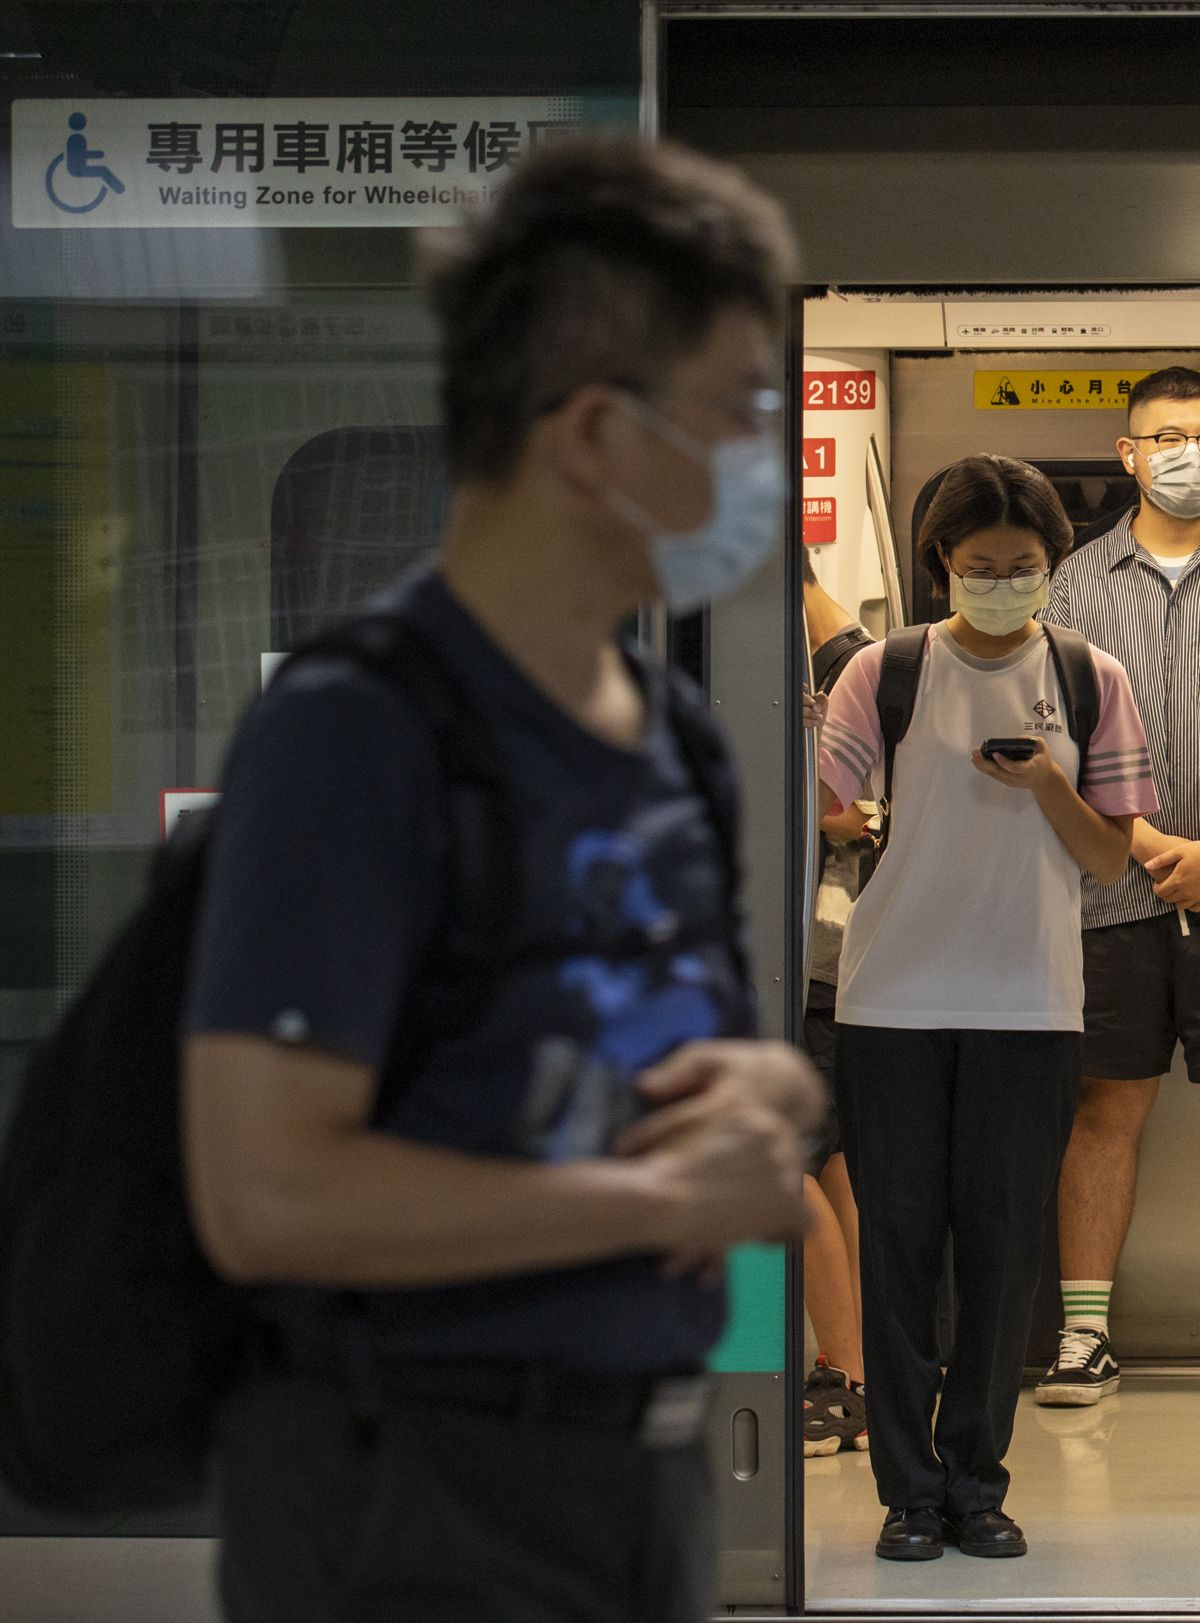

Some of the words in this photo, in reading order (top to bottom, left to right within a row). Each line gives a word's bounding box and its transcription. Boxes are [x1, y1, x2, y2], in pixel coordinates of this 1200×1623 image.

[146, 120, 578, 173] 專用車廂等候
[159, 186, 247, 209] Waiting
[255, 187, 314, 205] Zone
[323, 186, 356, 205] for
[807, 380, 871, 405] 2139
[1030, 379, 1131, 395] 小心月台
[803, 501, 832, 515] 講機
